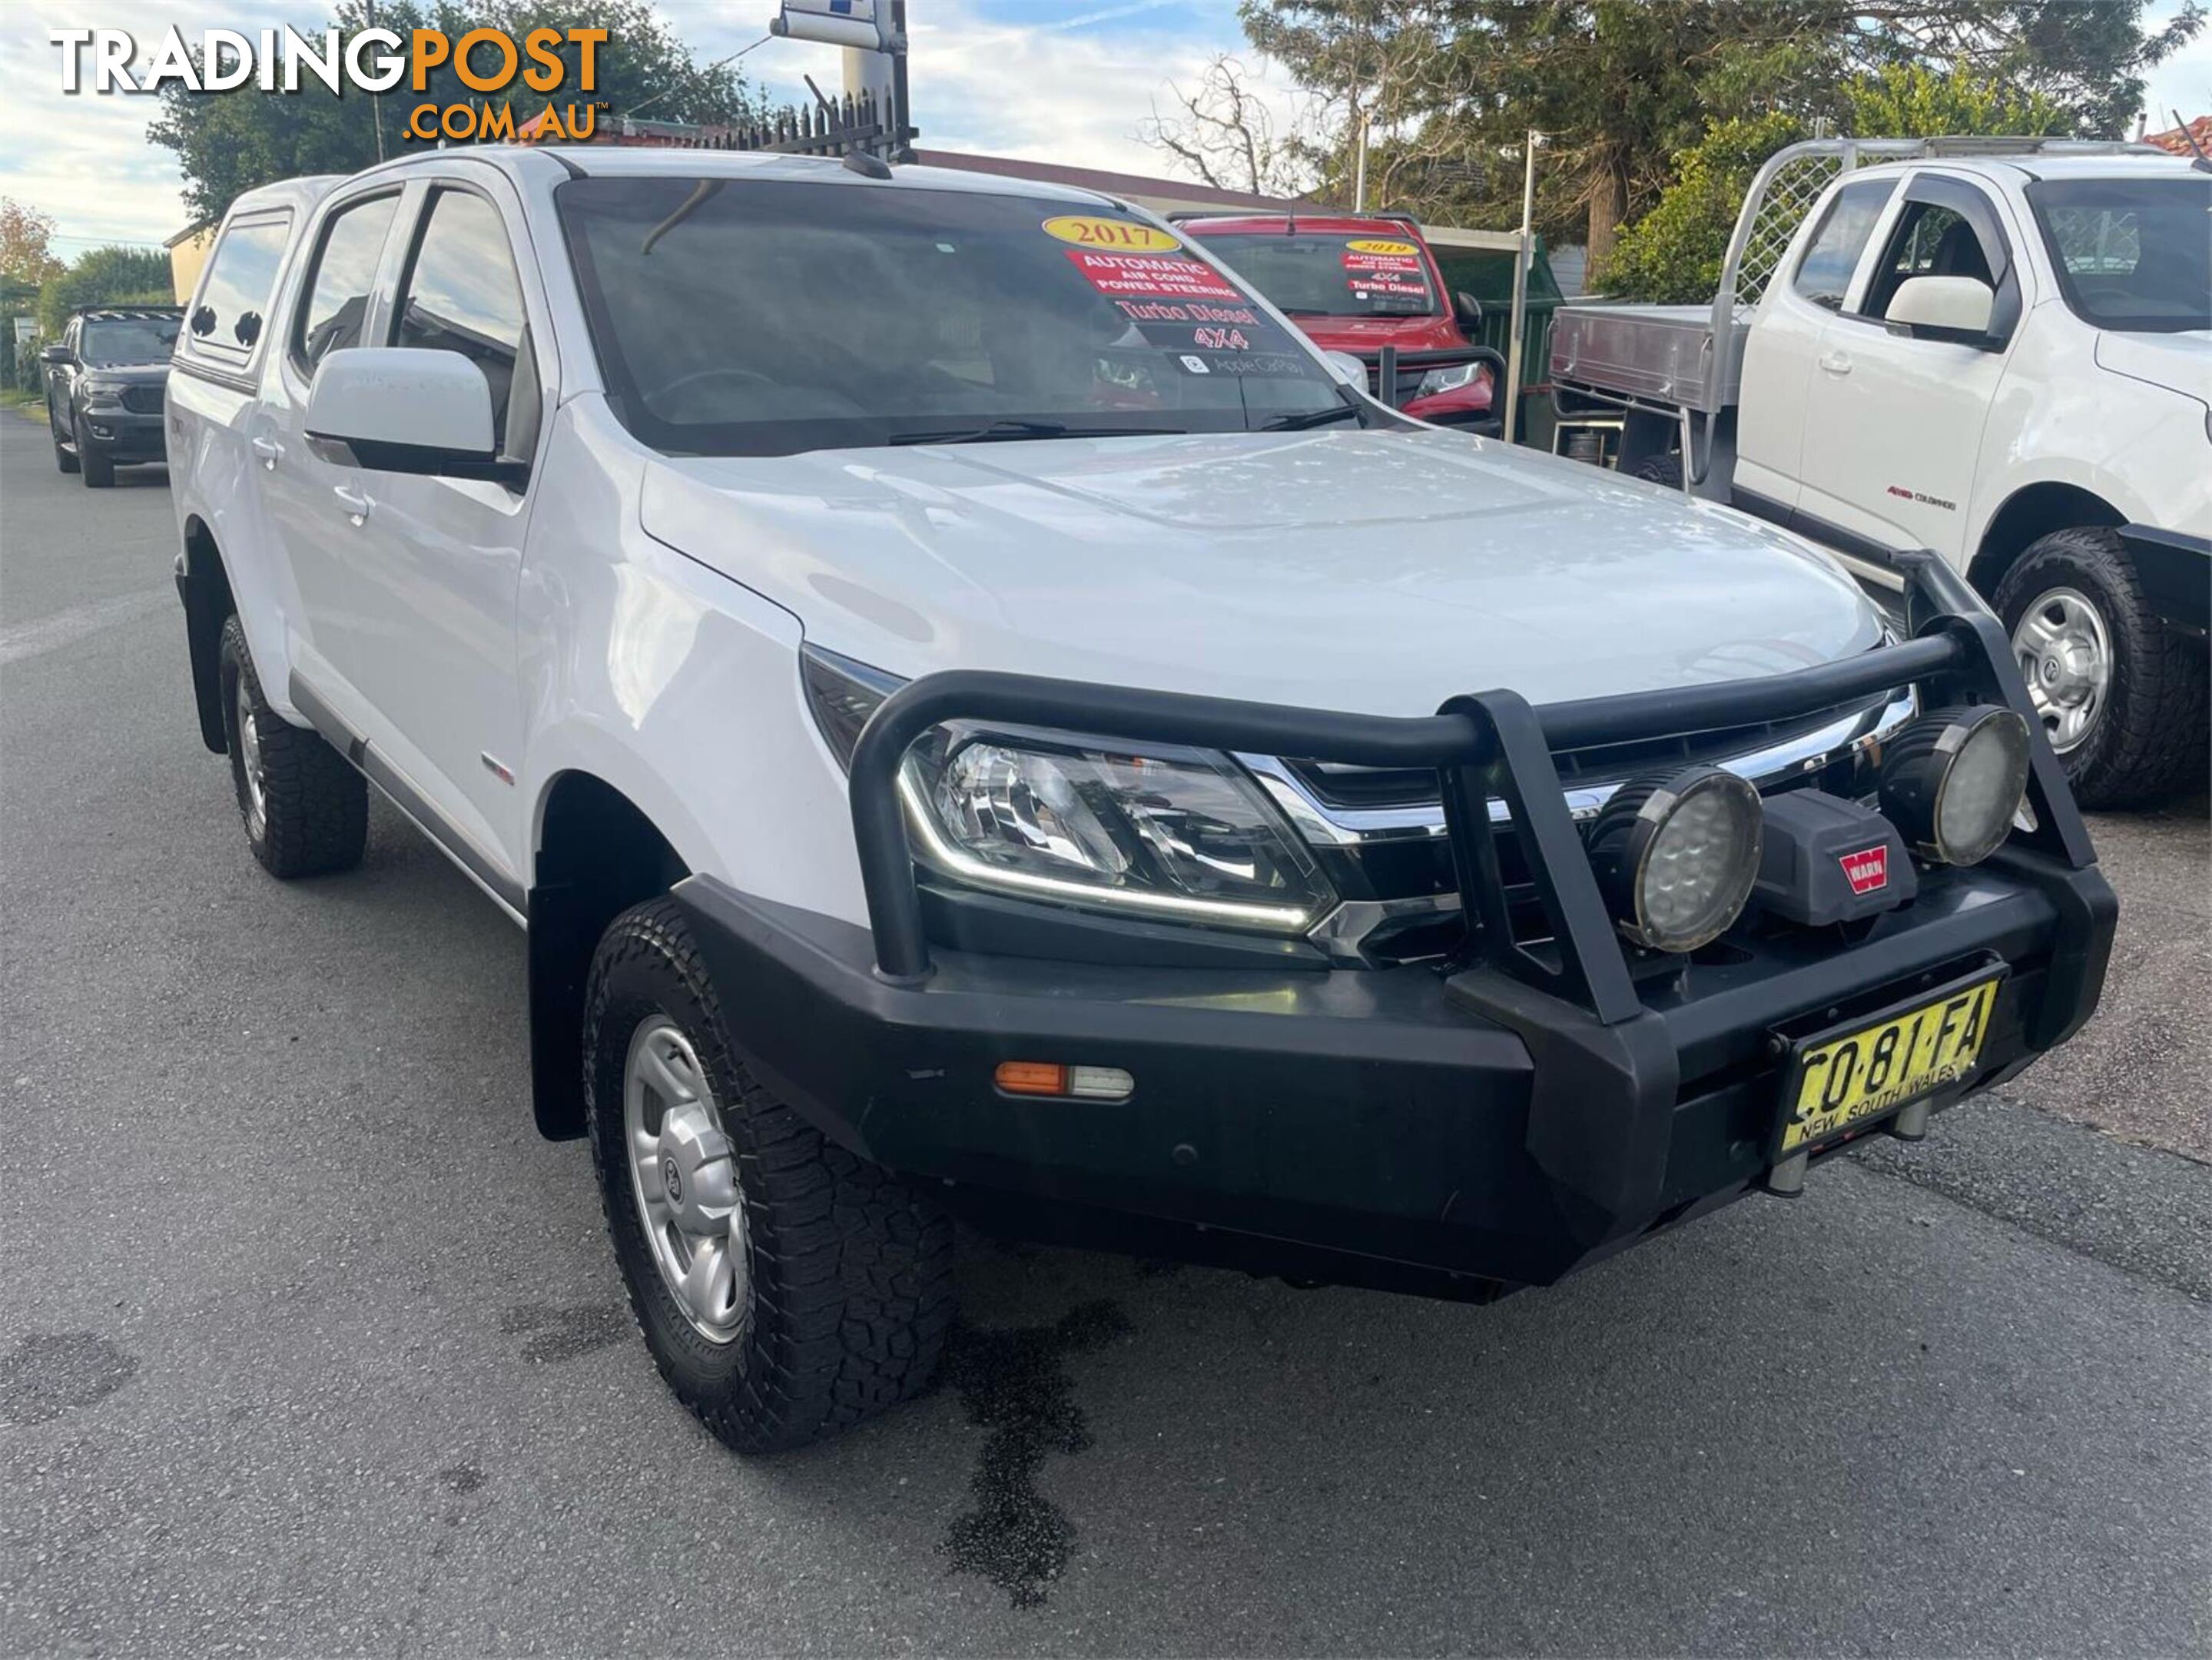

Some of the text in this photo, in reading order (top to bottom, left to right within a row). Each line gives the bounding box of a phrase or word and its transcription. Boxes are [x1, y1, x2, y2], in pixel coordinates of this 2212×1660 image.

[1071, 222, 1151, 246] 2017
[1084, 255, 1209, 277] AUTOMATIC
[1122, 271, 1150, 282] AIR
[1096, 279, 1239, 298] POWER STEERING
[1352, 280, 1424, 294] Turbo Diesel
[1115, 300, 1260, 326] Turbo Diesel
[1849, 859, 1883, 882] WARN
[1799, 1061, 1957, 1141] NEW SOUTH WALES
